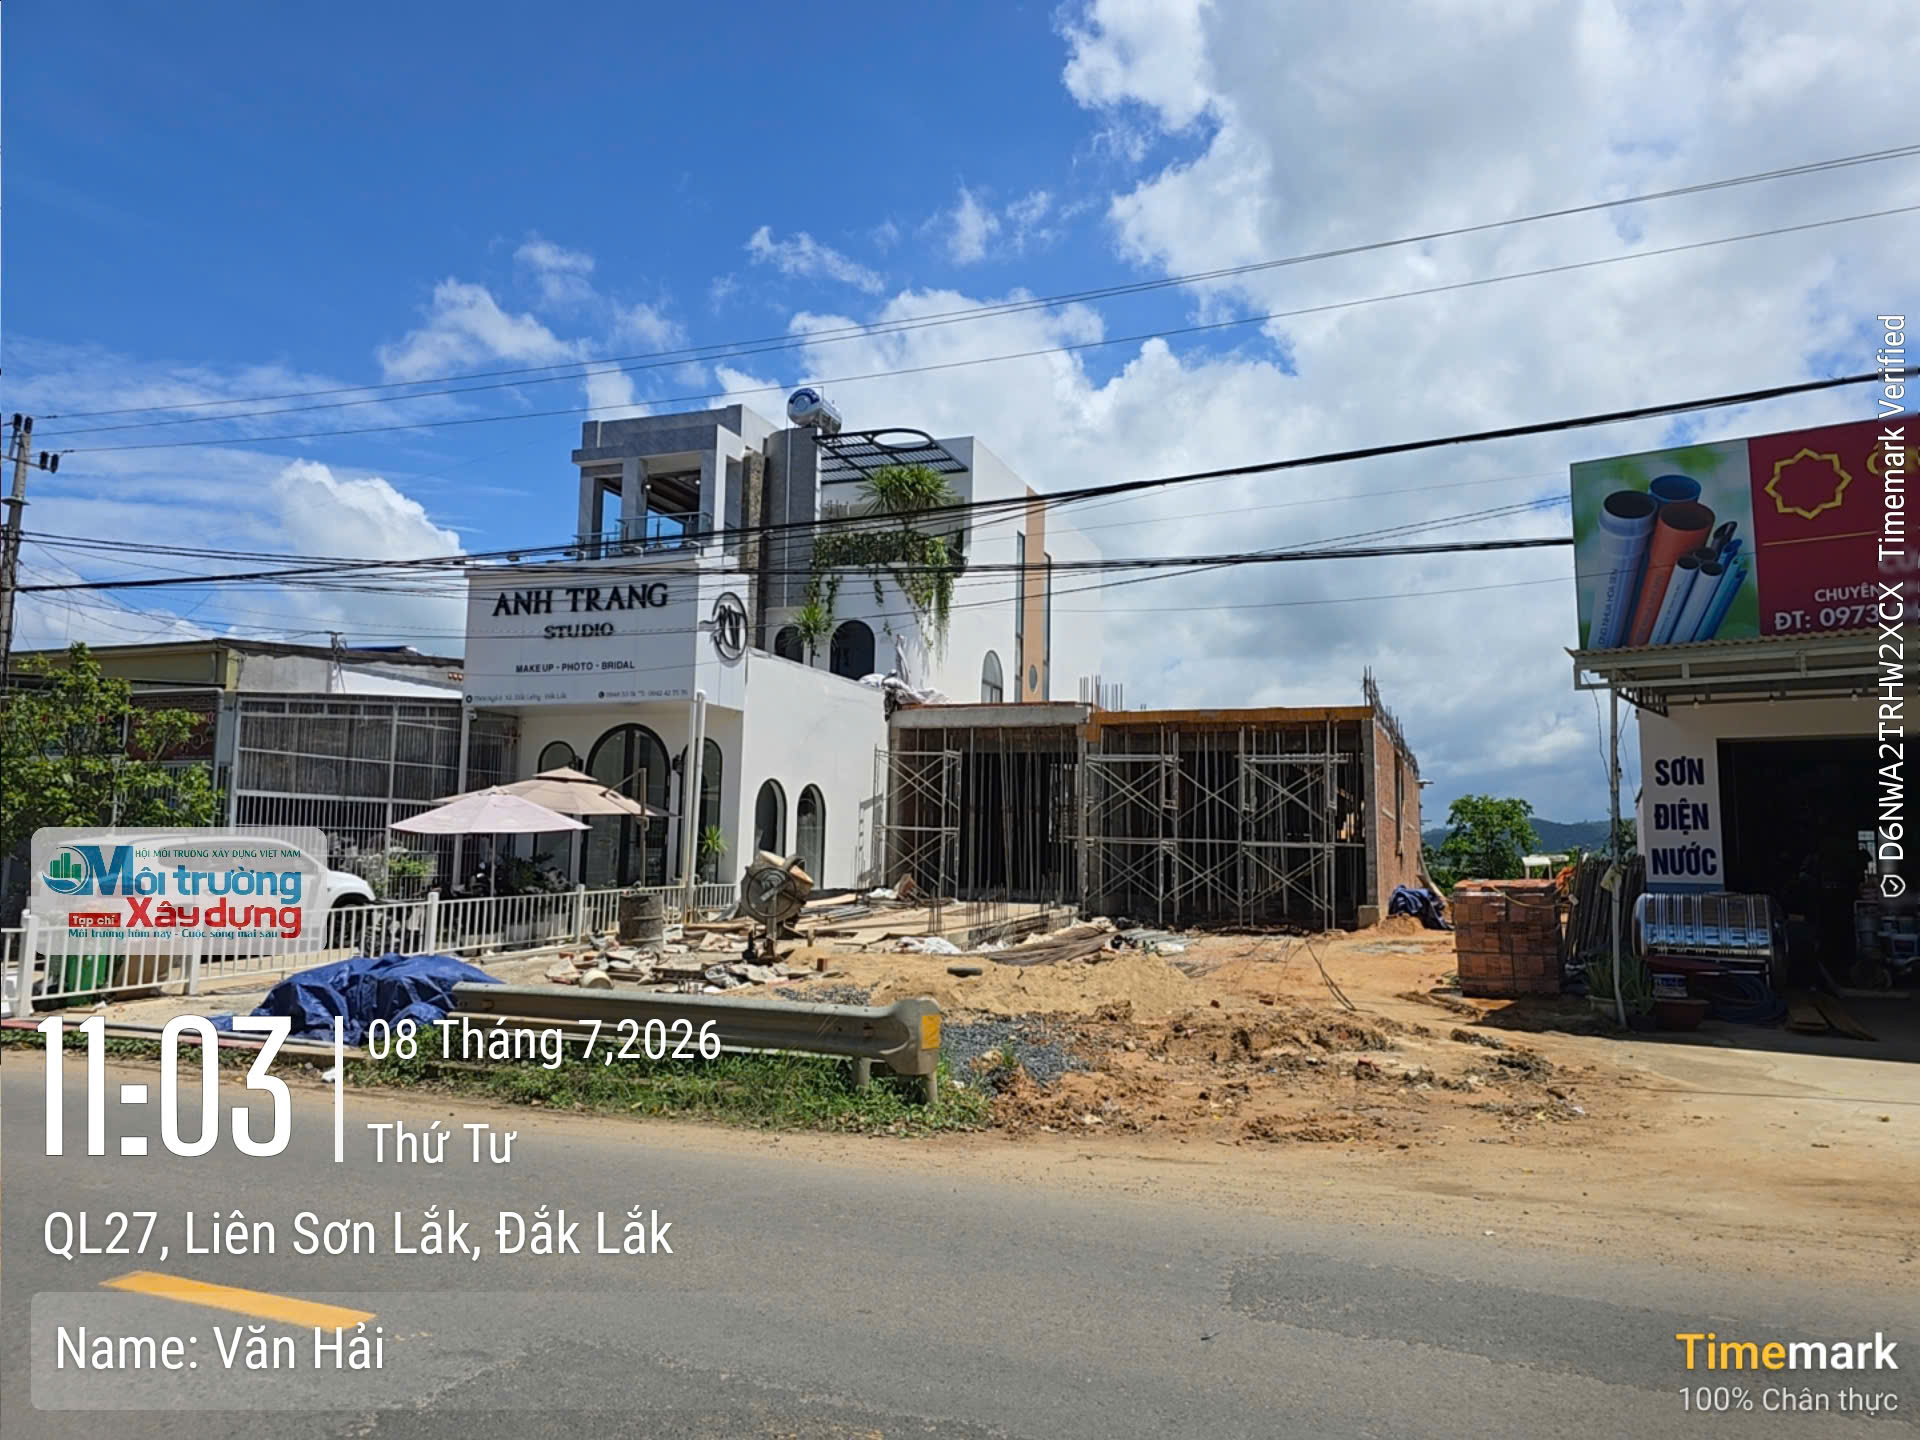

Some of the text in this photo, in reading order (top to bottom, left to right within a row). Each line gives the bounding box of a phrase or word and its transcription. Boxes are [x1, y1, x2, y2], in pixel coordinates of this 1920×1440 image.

[492, 583, 669, 617] ANH TRANG
[544, 622, 614, 640] STUDIO
[1774, 610, 1811, 631] ĐT:
[561, 662, 594, 672] PHOTO
[601, 660, 636, 670] BRIDAL
[1655, 756, 1705, 786] SƠN
[1654, 798, 1709, 836] ĐIỆN
[1652, 842, 1717, 876] NƯỚC
